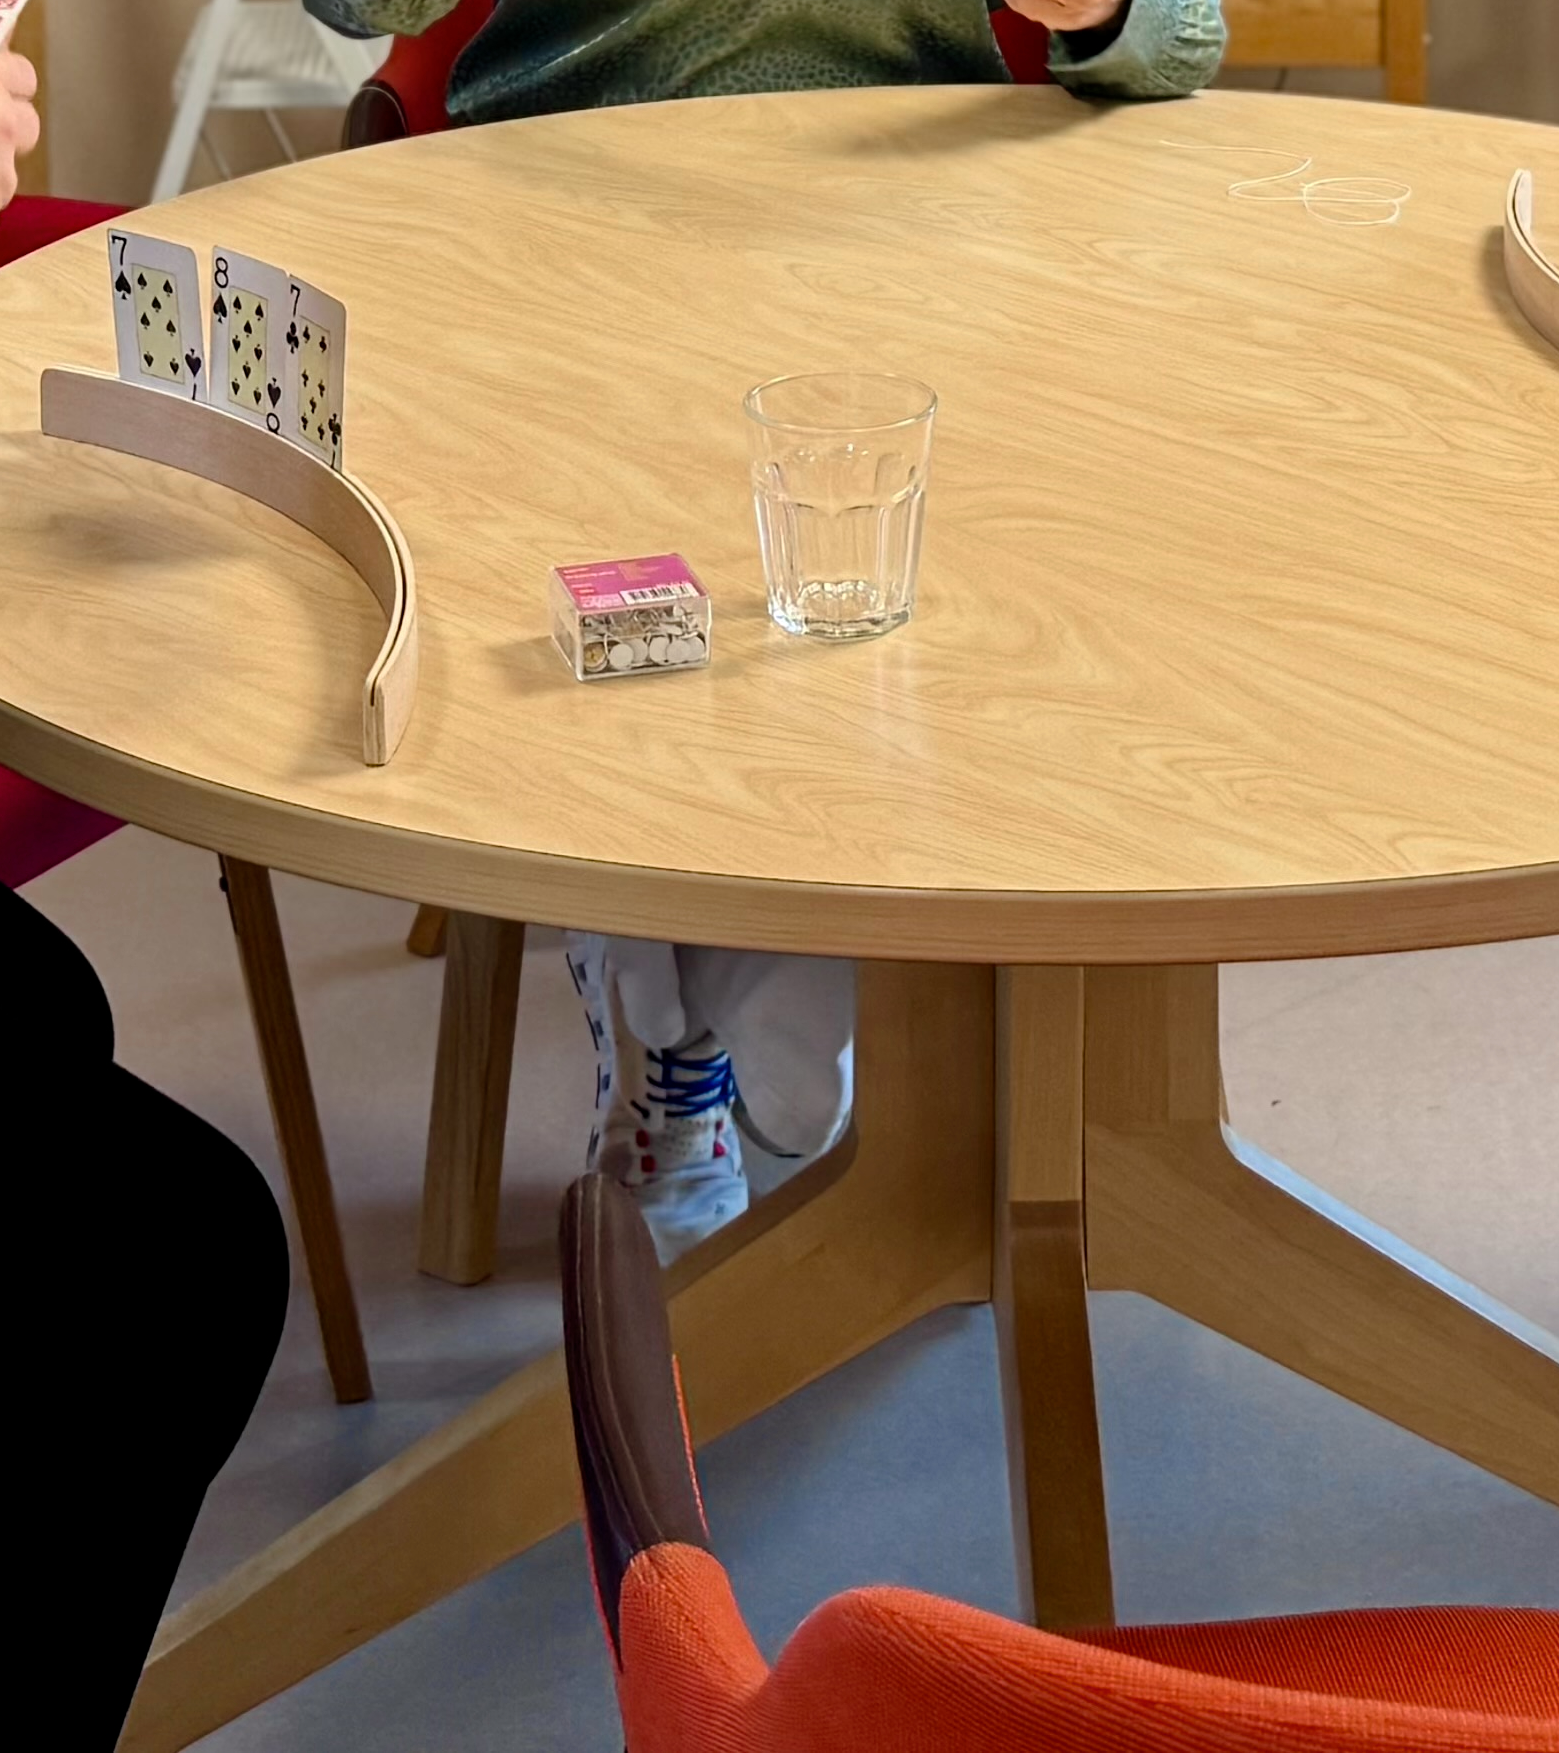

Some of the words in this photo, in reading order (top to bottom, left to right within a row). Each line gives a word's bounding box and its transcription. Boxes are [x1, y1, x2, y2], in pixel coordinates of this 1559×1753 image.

[111, 235, 127, 266] 7
[214, 256, 229, 289] 8
[290, 283, 301, 317] 7
